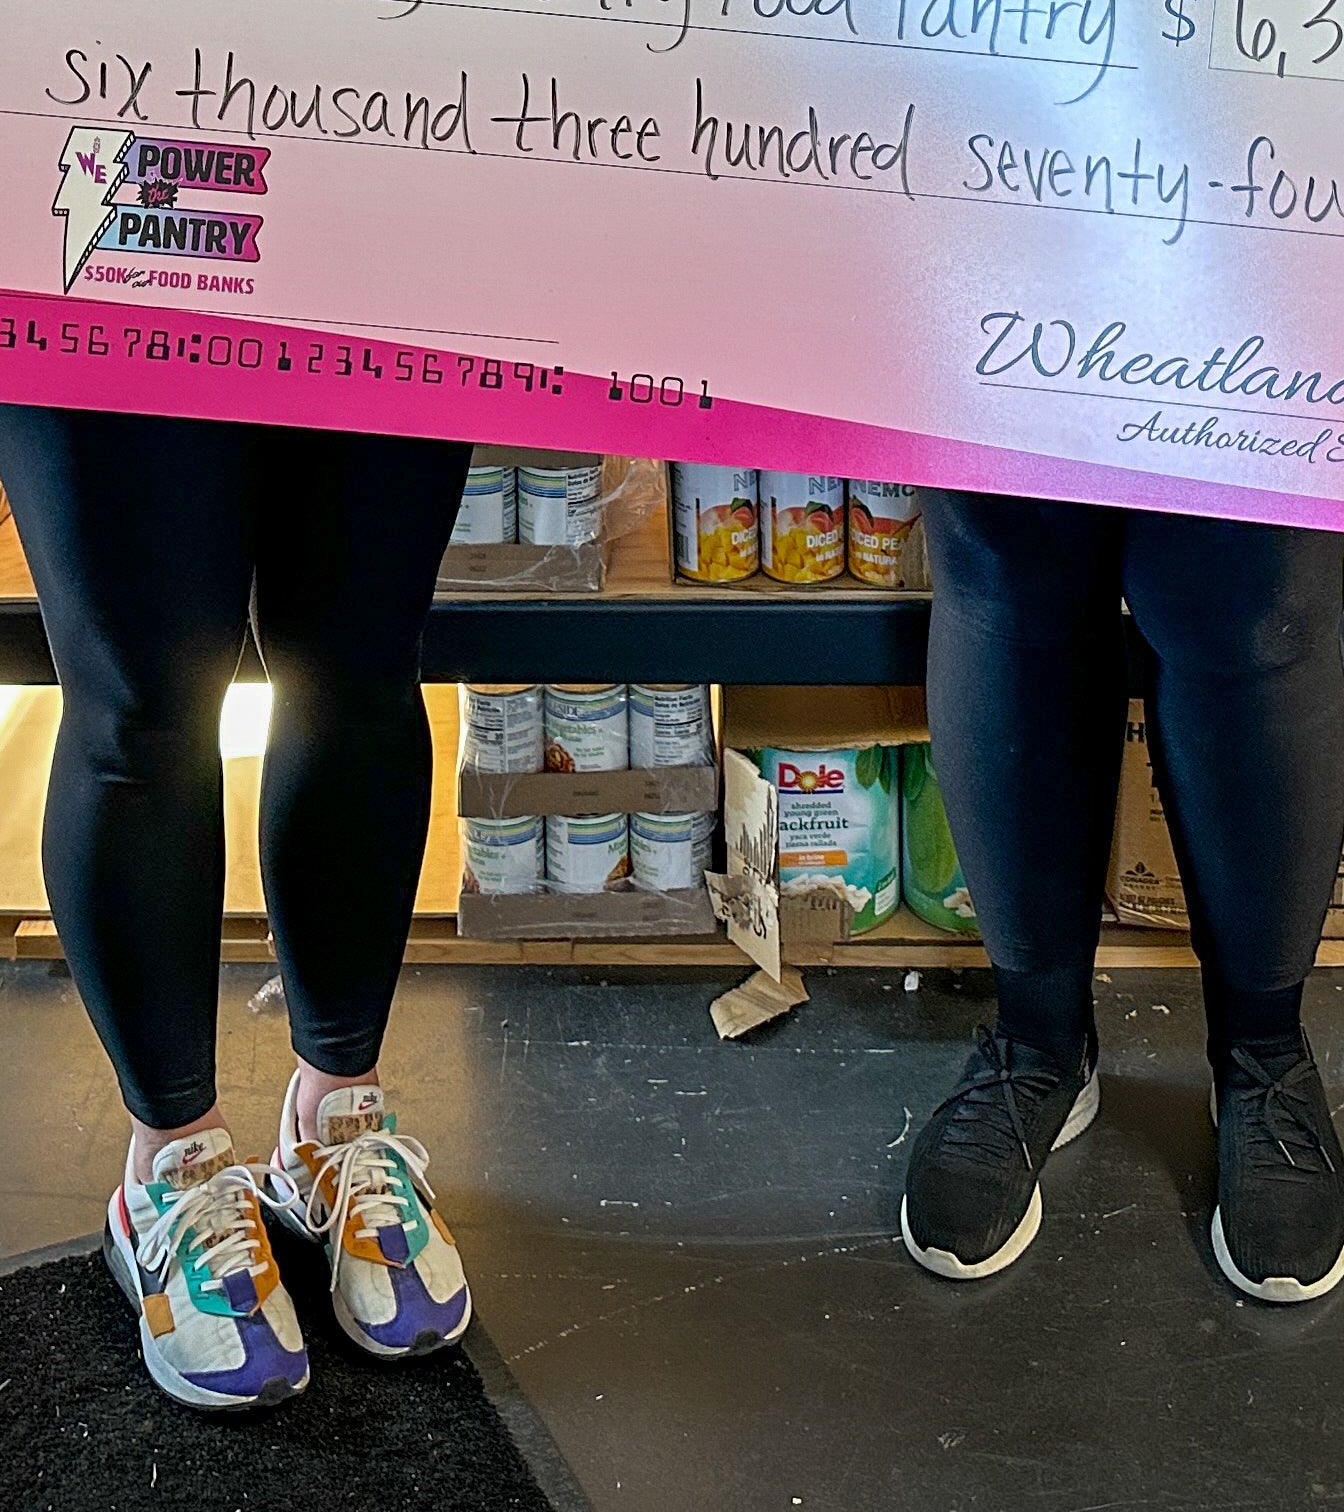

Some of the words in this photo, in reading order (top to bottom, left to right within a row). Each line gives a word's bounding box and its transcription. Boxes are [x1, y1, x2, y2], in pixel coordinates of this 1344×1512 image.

[175, 48, 479, 156] thousand
[491, 72, 662, 164] three
[690, 78, 916, 201] hundred
[137, 144, 256, 187] POWER
[118, 212, 253, 256] PANTRY
[84, 265, 128, 285] $50K
[148, 270, 192, 290] FOOD
[196, 274, 255, 295] BANKS
[1115, 409, 1326, 465] Authorized
[777, 762, 846, 794] Dole
[779, 817, 849, 832] ackfruit
